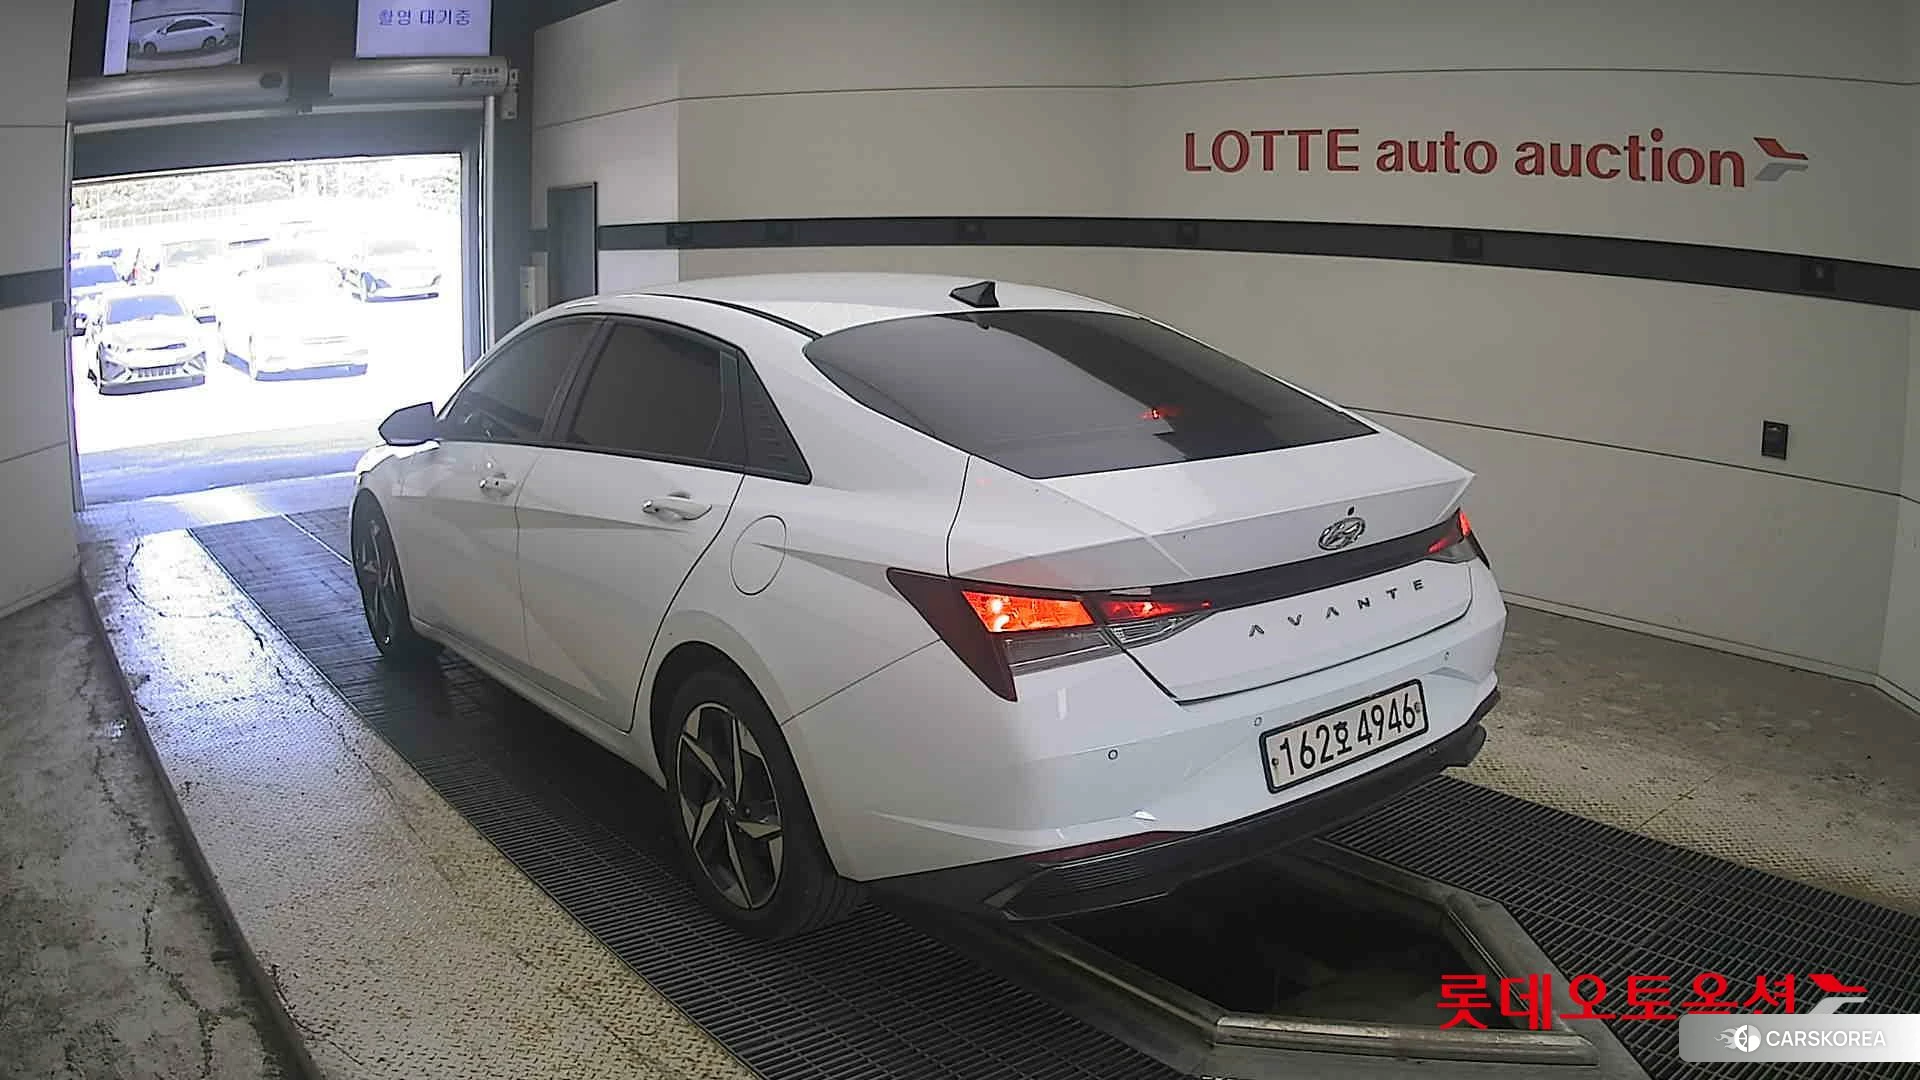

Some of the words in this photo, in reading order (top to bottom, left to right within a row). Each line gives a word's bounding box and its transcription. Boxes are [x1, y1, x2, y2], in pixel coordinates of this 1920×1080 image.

[1184, 128, 1360, 173] LOTTE
[1376, 130, 1498, 175] auto
[1514, 127, 1746, 188] auction
[1248, 578, 1426, 638] AVANTE
